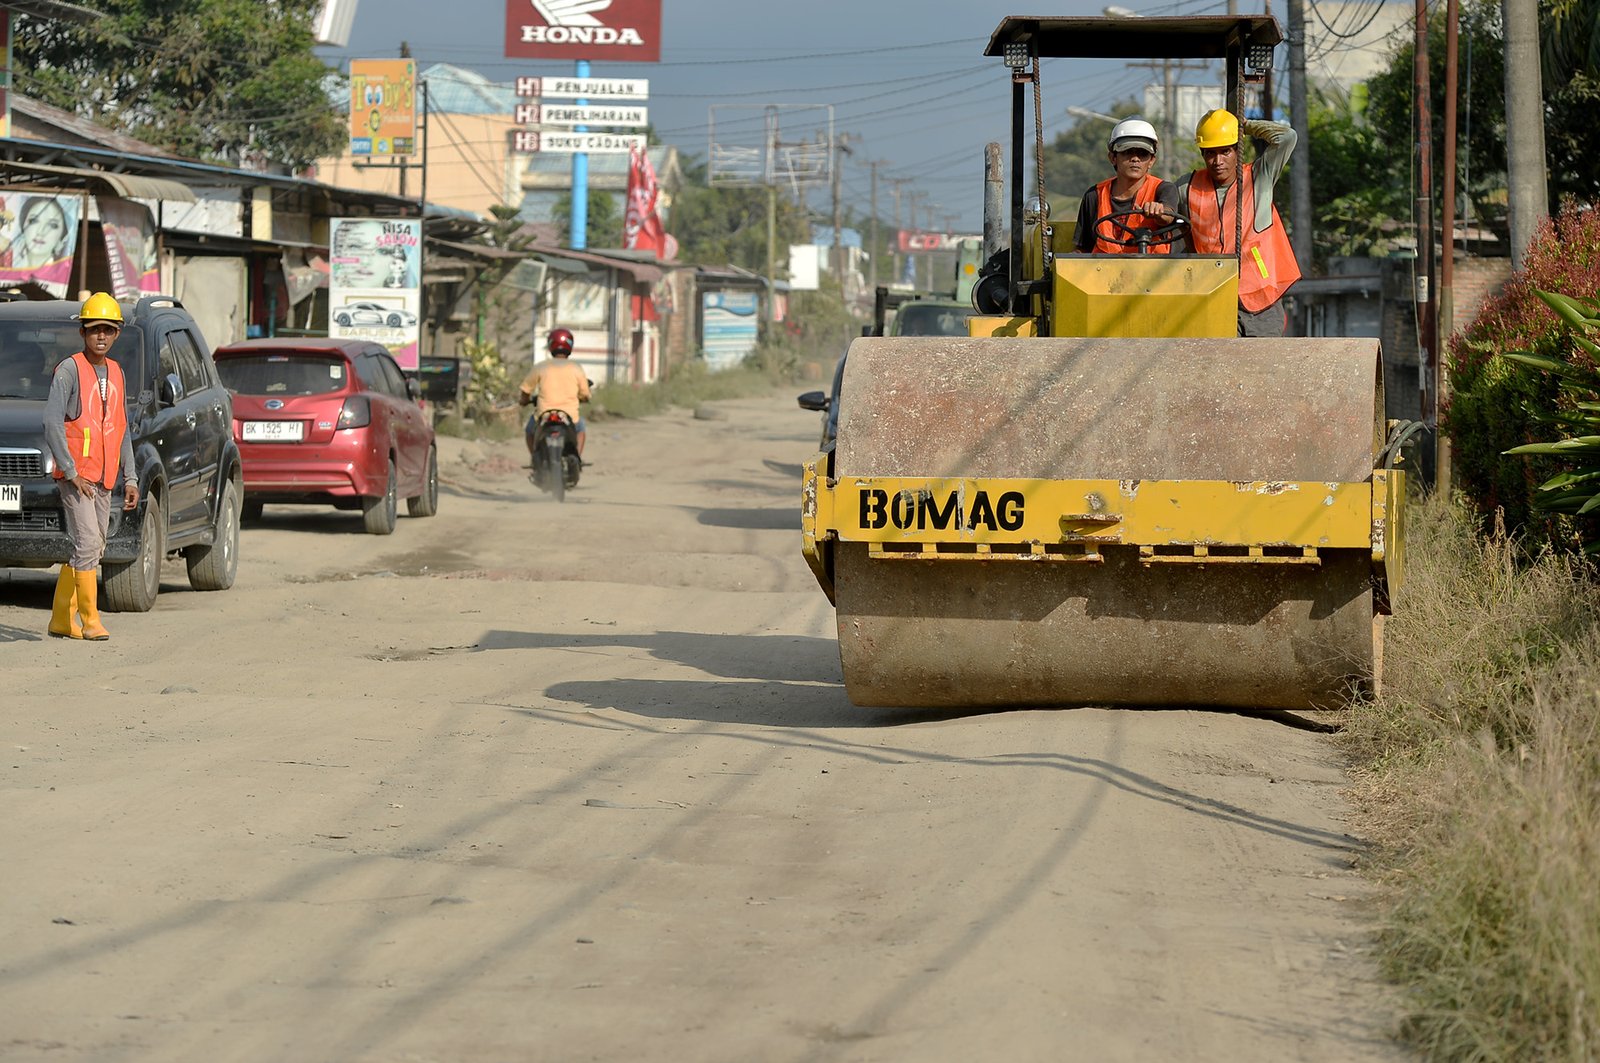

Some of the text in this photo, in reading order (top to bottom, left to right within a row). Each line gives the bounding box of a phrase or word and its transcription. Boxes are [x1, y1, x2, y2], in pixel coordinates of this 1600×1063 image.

[520, 25, 645, 45] HONDA
[555, 82, 634, 95] PENJUALAN
[547, 109, 641, 121] PEMELIHARAAN
[548, 137, 581, 148] SUKU
[588, 138, 639, 149] CADANG
[383, 223, 411, 235] NISA
[246, 423, 256, 434] BK
[262, 423, 282, 433] 1525
[2, 487, 18, 501] MN
[859, 489, 1025, 531] BOMAG
